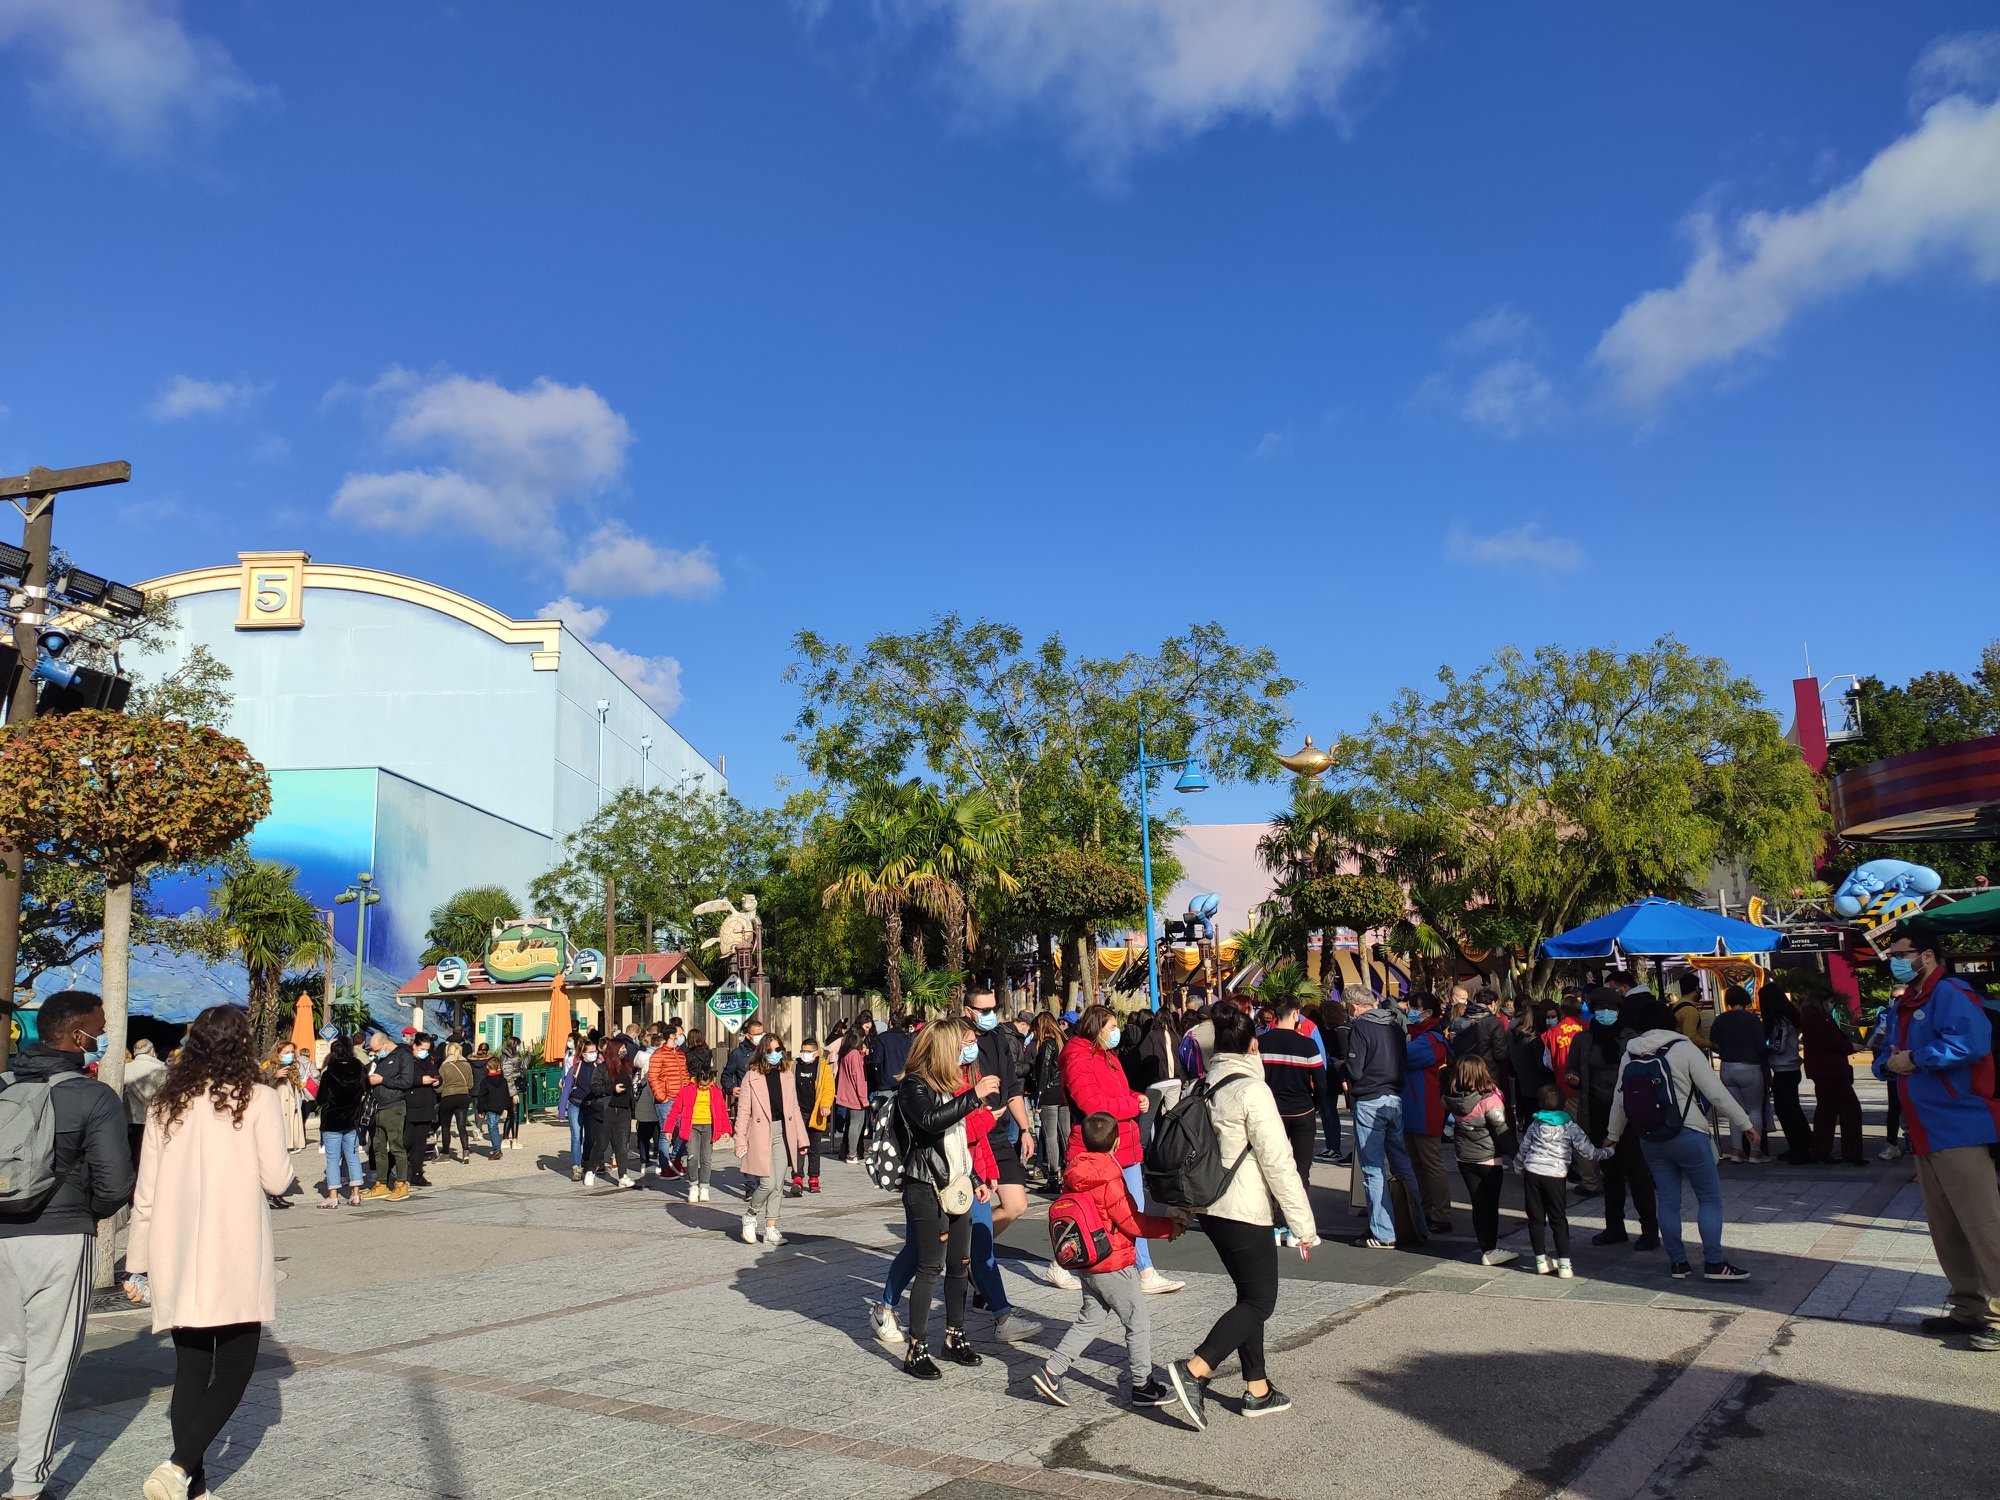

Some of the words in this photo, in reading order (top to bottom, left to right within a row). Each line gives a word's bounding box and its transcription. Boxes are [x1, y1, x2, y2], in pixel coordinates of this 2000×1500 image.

[254, 574, 288, 613] 5
[490, 947, 559, 967] COASTER
[714, 999, 752, 1010] COASTER
